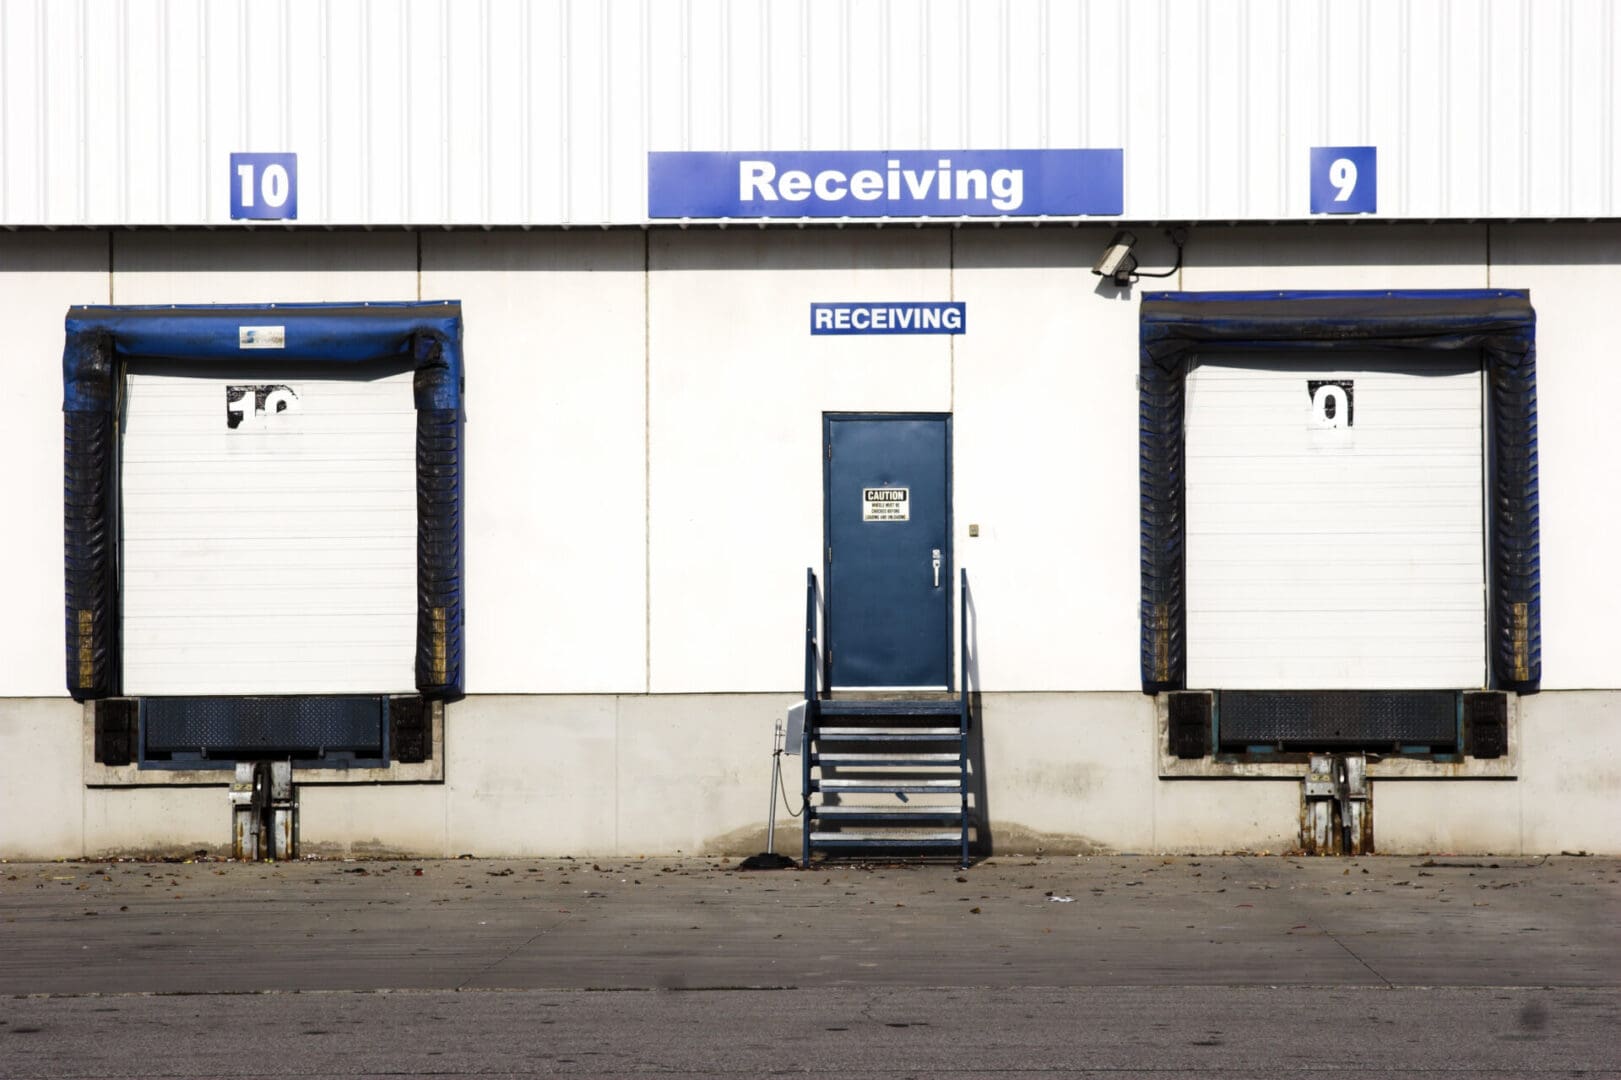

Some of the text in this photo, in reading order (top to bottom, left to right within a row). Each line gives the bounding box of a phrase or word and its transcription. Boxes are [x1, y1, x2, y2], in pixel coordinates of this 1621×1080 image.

[237, 163, 290, 208] 10
[739, 158, 1024, 211] Receiving
[1328, 158, 1358, 202] 9
[815, 307, 961, 329] RECEIVING
[867, 490, 904, 500] CAUTION
